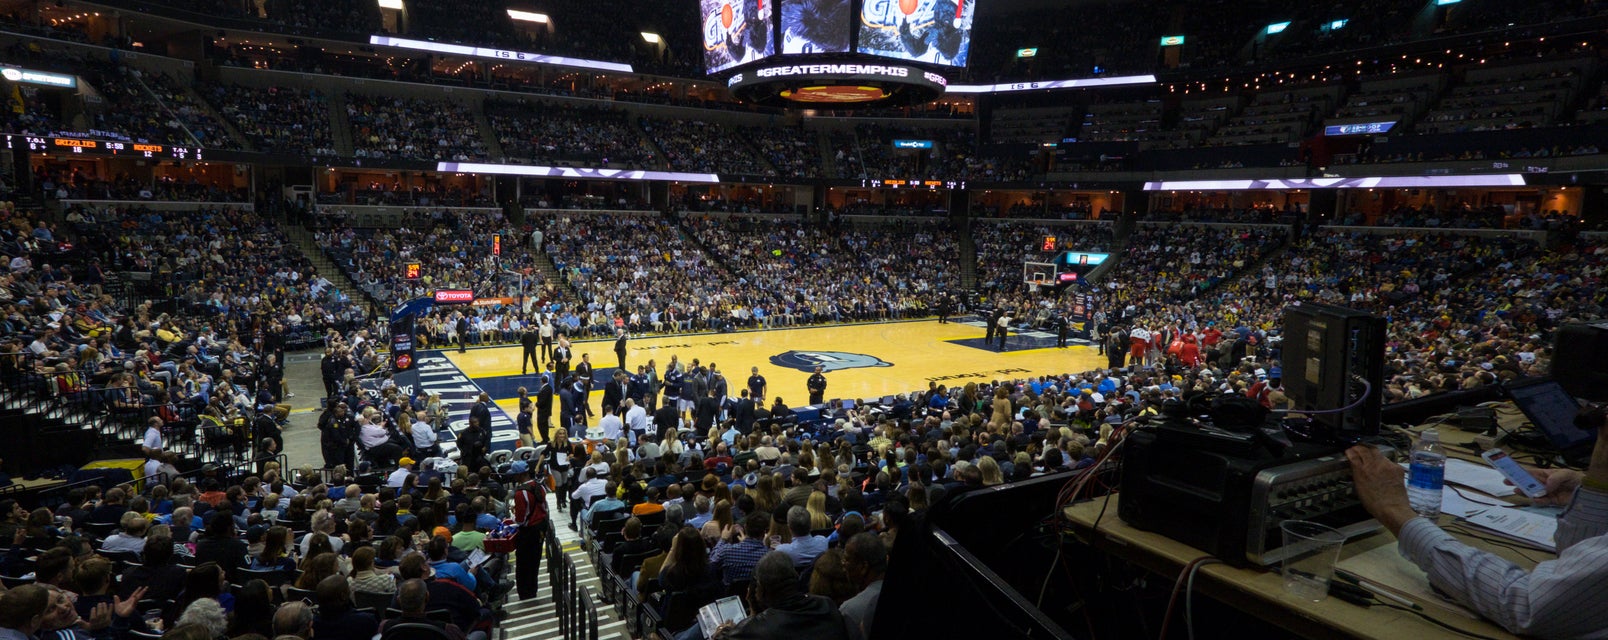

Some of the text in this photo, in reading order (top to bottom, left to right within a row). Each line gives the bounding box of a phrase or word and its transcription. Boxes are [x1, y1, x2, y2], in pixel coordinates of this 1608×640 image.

[757, 65, 908, 78] #GREATERMEMPHIS
[55, 138, 97, 148] GRIZZLIES
[133, 143, 163, 153] ROCKETS
[1044, 243, 1055, 251] 24
[447, 292, 472, 300] TOYOTA
